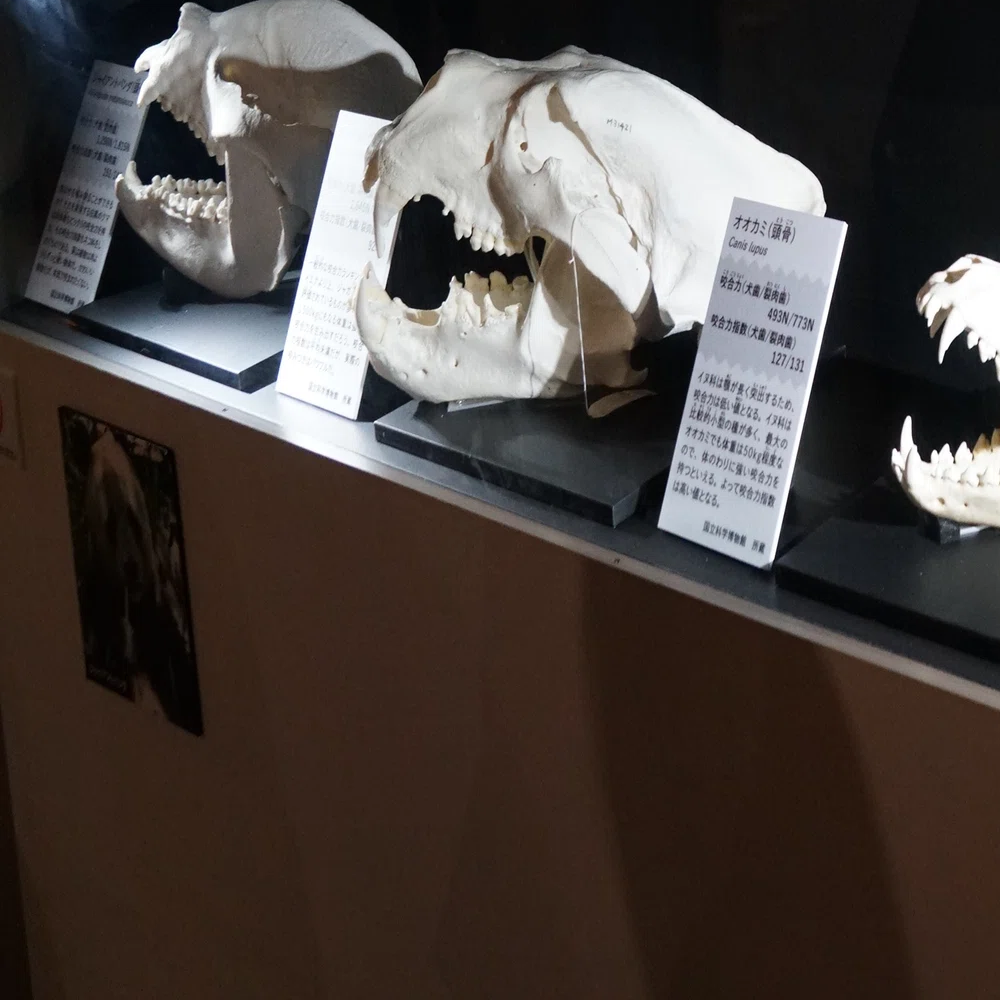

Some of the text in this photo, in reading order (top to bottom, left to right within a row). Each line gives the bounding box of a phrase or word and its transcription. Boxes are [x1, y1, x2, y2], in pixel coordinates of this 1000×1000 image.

[732, 214, 797, 245] オオカミ(頭骨)
[728, 235, 769, 257] Canis lupus
[767, 307, 816, 333] 493N/773N
[770, 350, 806, 376] 127/131
